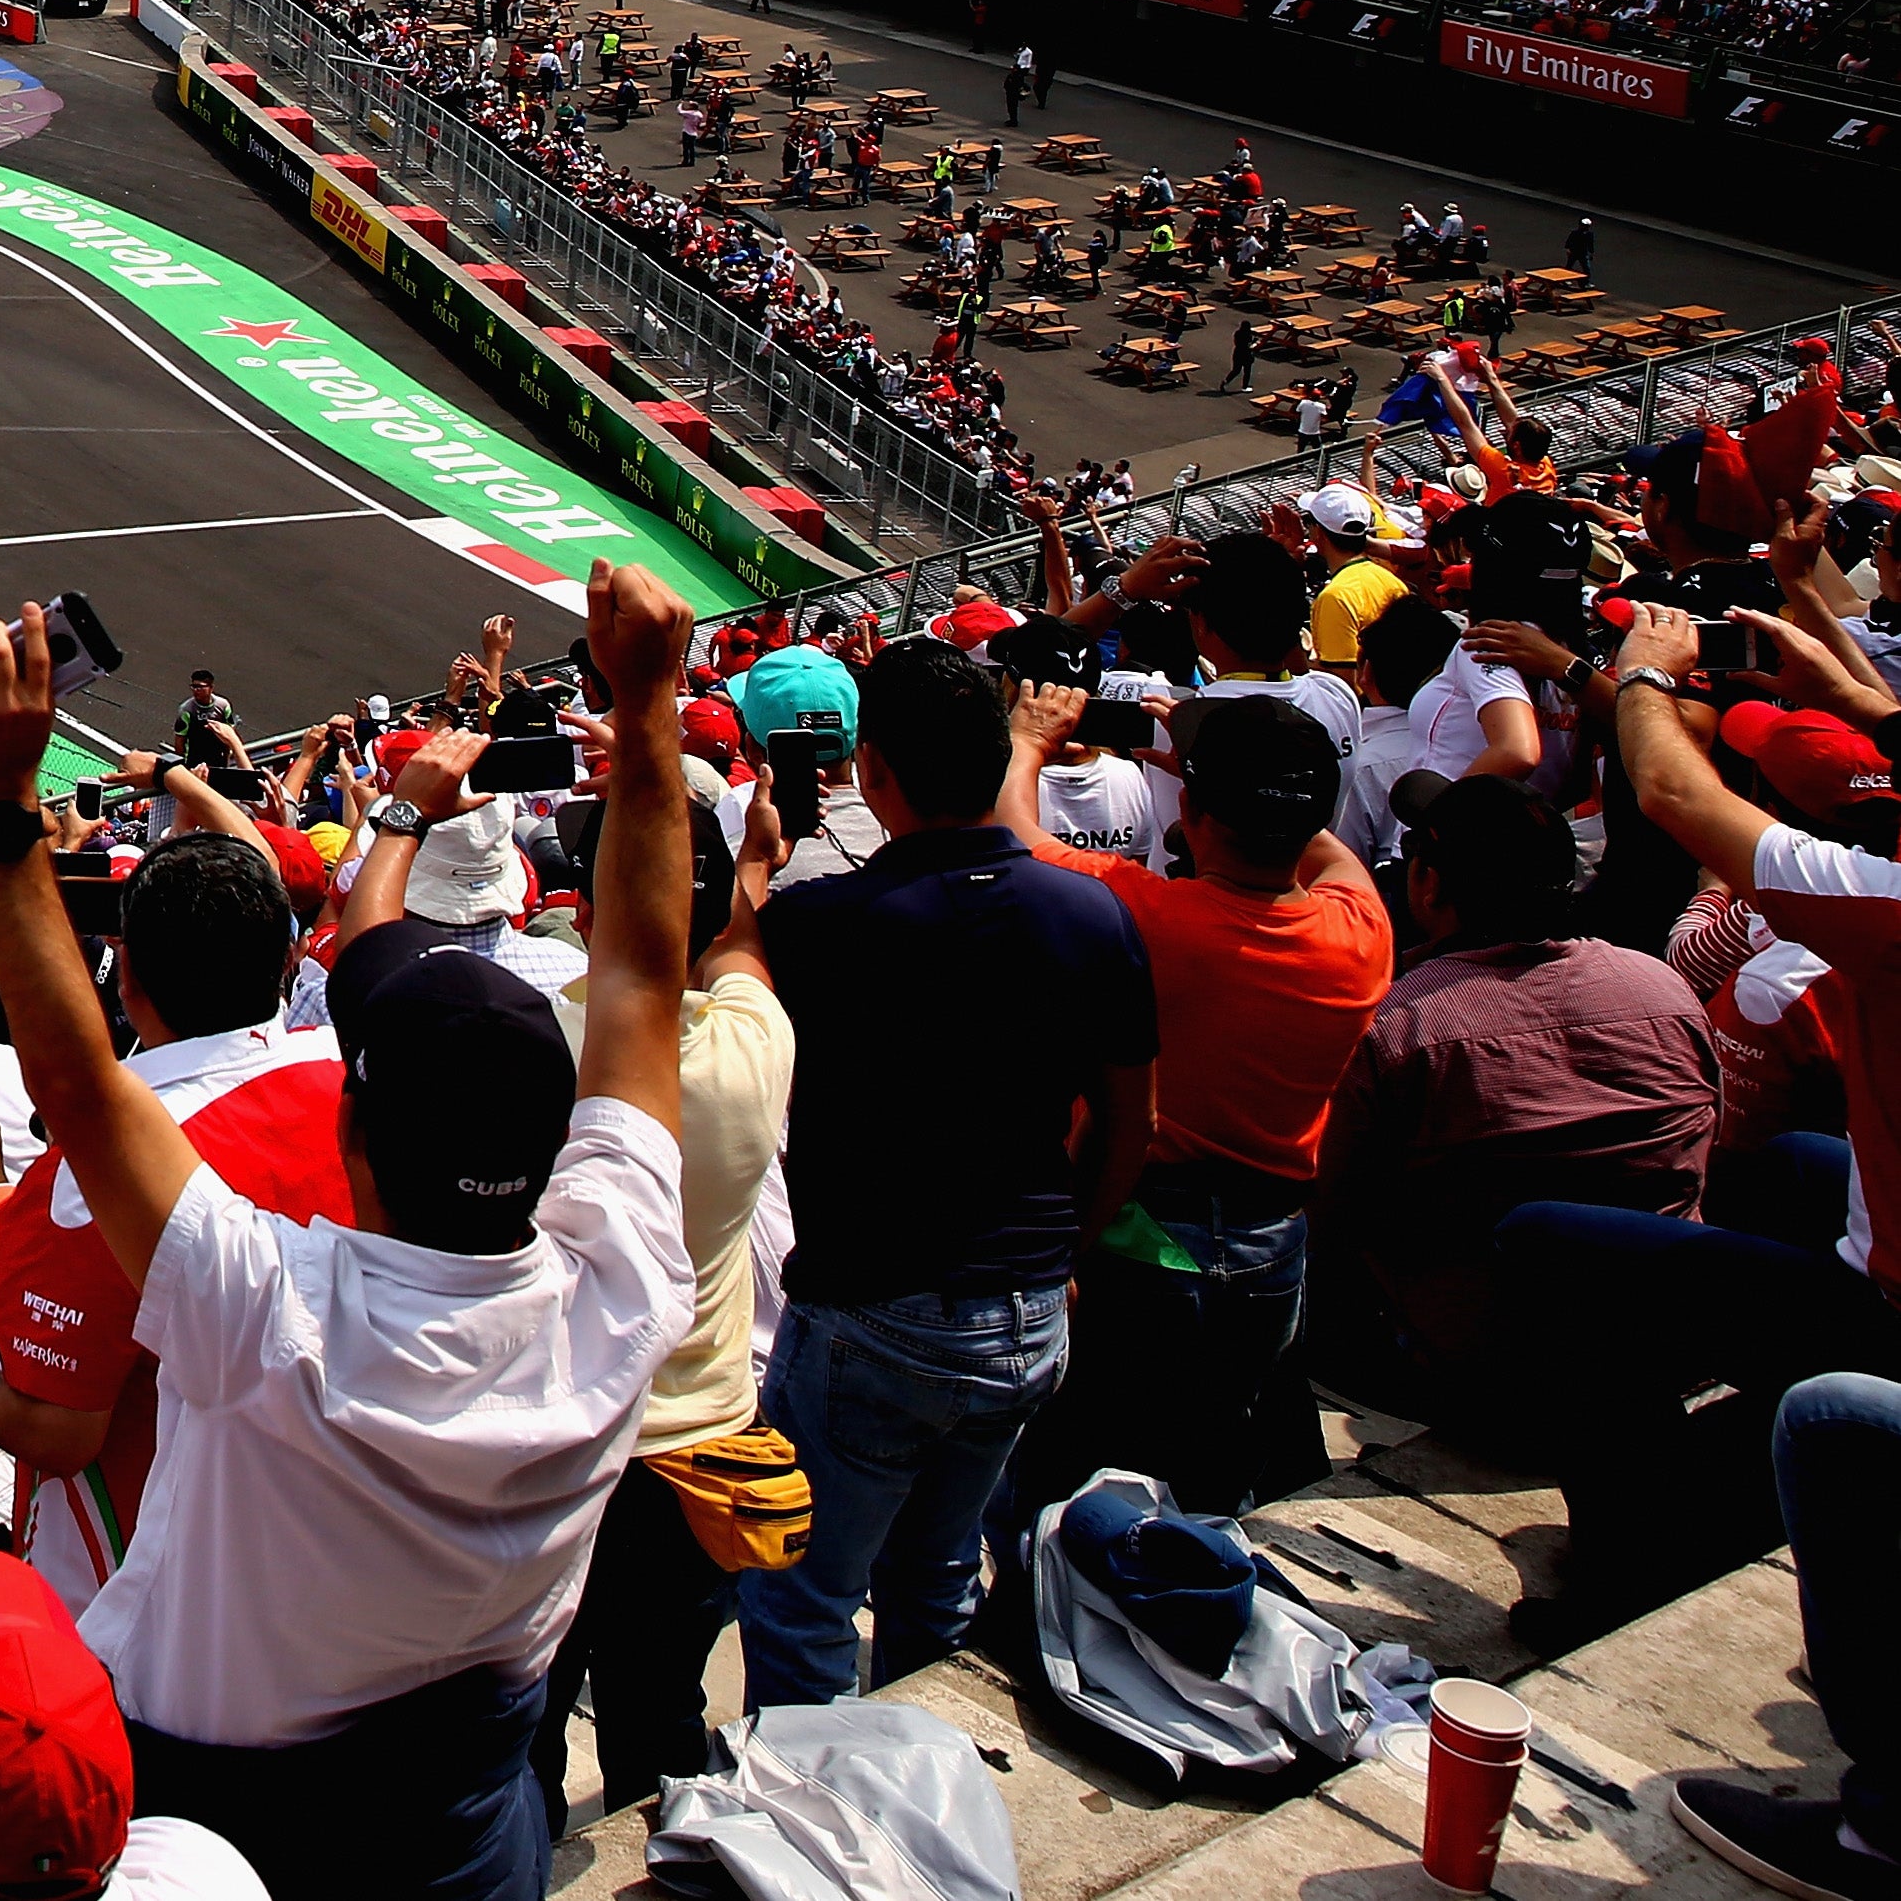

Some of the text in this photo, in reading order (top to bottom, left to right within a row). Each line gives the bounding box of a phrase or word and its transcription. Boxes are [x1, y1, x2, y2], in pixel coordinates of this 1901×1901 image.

[1466, 35, 1655, 100] Fly Emirates
[281, 163, 310, 197] WALKER
[320, 189, 372, 256] DHL
[392, 266, 417, 300] ROLEX
[432, 298, 460, 333] ROLEX
[474, 334, 503, 369] ROLEX
[519, 373, 550, 411] ROLEX
[276, 353, 637, 545] Heineken
[568, 414, 601, 454] ROLEX
[621, 457, 655, 500] ROLEX
[676, 508, 715, 551] ROLEX
[737, 555, 780, 599] ROLEX
[458, 1177, 527, 1196] CUBS
[23, 1289, 85, 1327] WEICHAI
[12, 1335, 71, 1372] KASPERSKY
